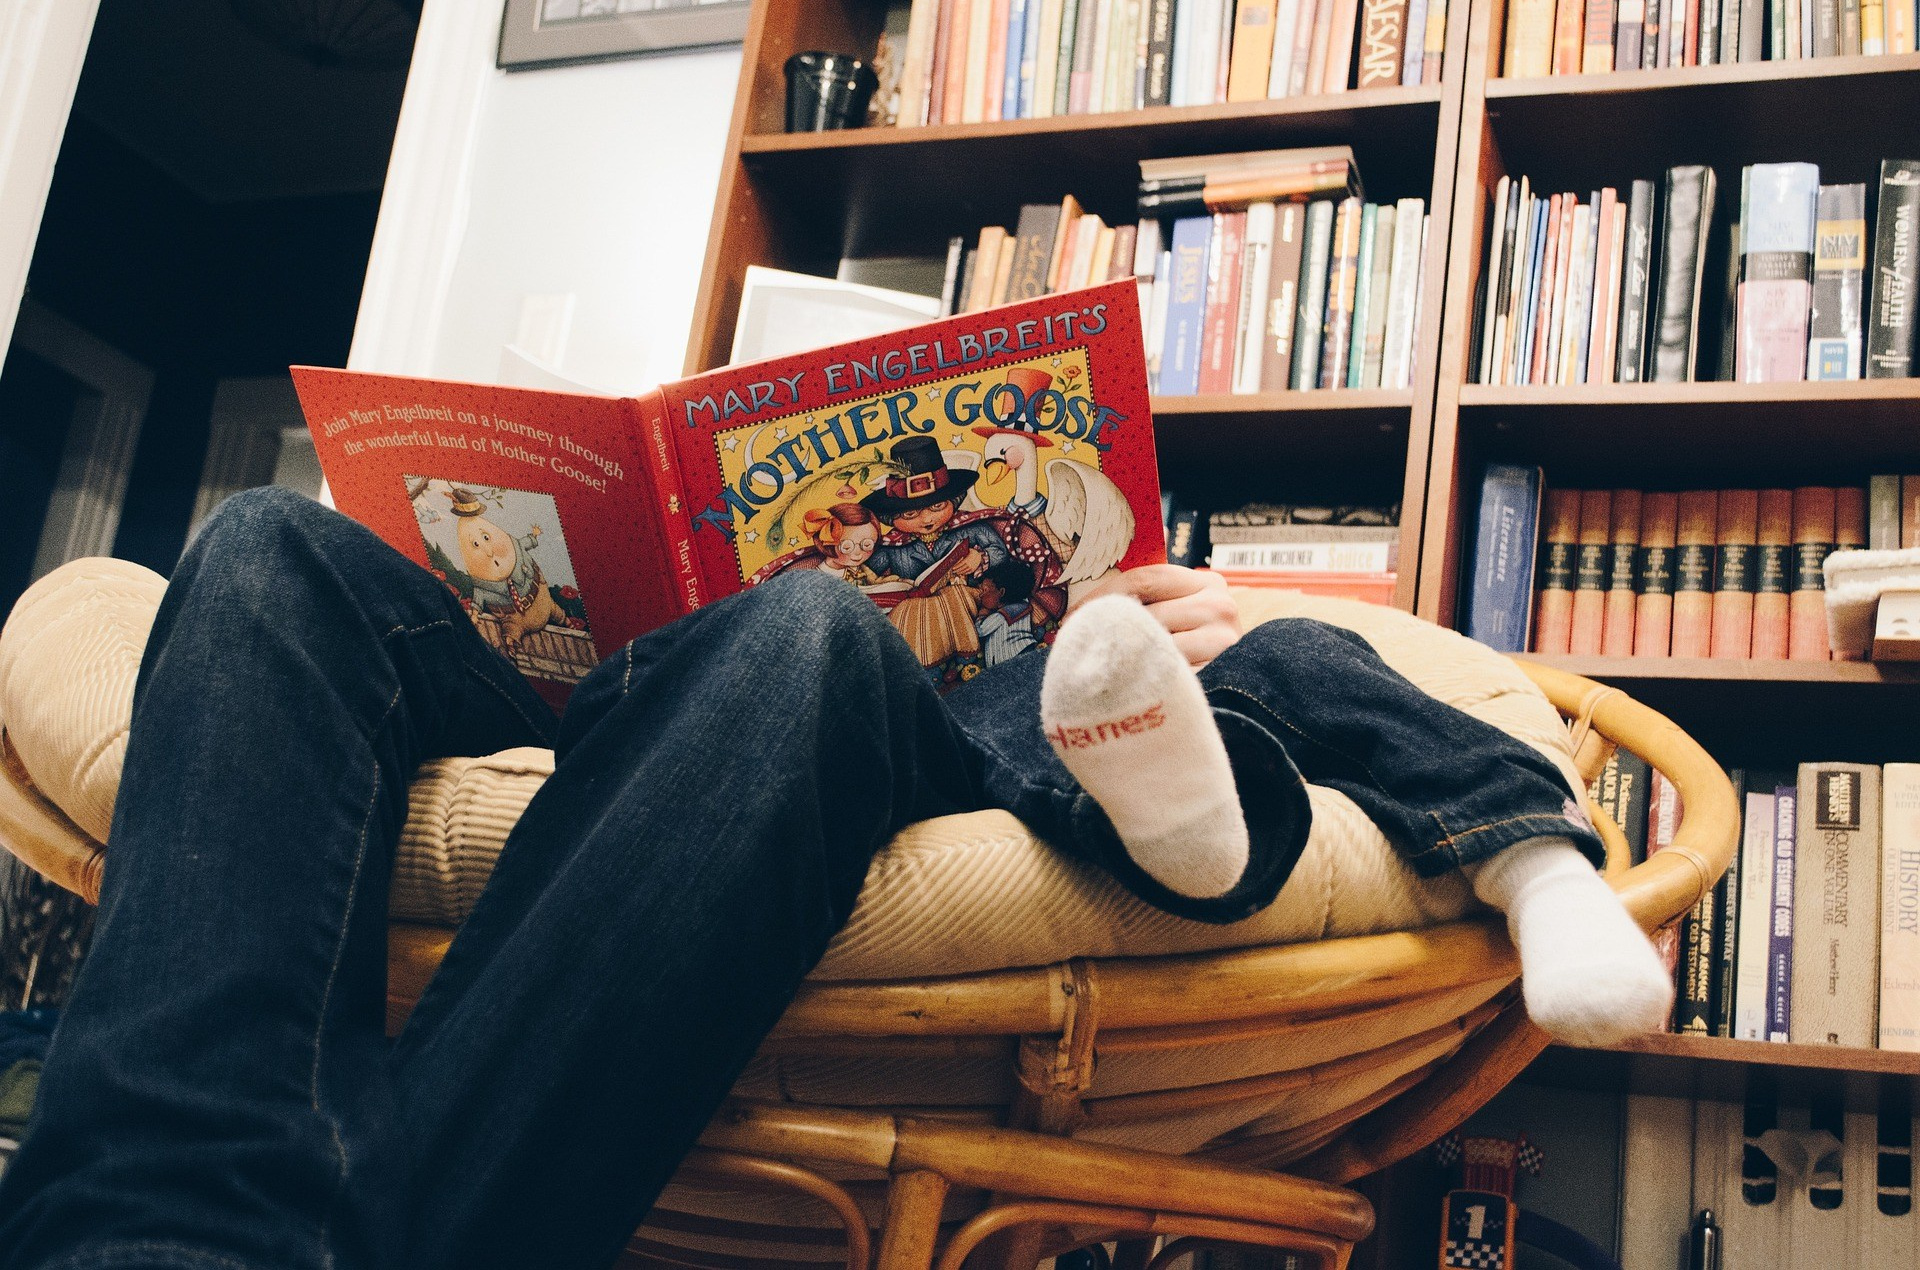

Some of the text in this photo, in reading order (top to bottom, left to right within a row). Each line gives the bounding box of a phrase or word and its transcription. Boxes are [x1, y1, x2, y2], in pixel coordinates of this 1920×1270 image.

[1361, 0, 1405, 87] AESAR
[1824, 234, 1855, 247] NIV
[1893, 204, 1911, 269] WOMEN
[1889, 279, 1909, 328] FAITH
[684, 371, 806, 428] MARY
[823, 304, 1107, 395] ENGELBREIT'S
[323, 404, 625, 481] Join Mary Engelbreit on a journey through
[343, 430, 607, 494] the wonderful land of Mother Goose!
[651, 417, 671, 472] Engelbreit
[691, 380, 1129, 546] MOTHER GOOSE
[1227, 549, 1255, 566] JAMES
[1271, 550, 1313, 566] MICHENER
[1497, 505, 1515, 583] Literature
[677, 539, 701, 612] Mary Enge
[1894, 792, 1920, 801] UPDA
[1776, 839, 1793, 858] OLD
[1824, 848, 1835, 873] ONE
[1775, 857, 1792, 907] TESTAMENT
[1823, 876, 1835, 925] VOLUME
[1835, 831, 1849, 928] COMMENTARY
[1885, 873, 1896, 934] TESTAMENT
[1899, 850, 1920, 935] HISTORY
[1689, 922, 1699, 944] OLD
[1700, 930, 1711, 955] AND
[1723, 919, 1735, 961] SYNTAX
[1774, 907, 1791, 937] CODES
[1686, 944, 1698, 1001] TESTAMENT
[1697, 955, 1709, 1003] ARAMAIC
[1880, 1027, 1920, 1038] HENDRIC
[1465, 1205, 1486, 1239] 1
